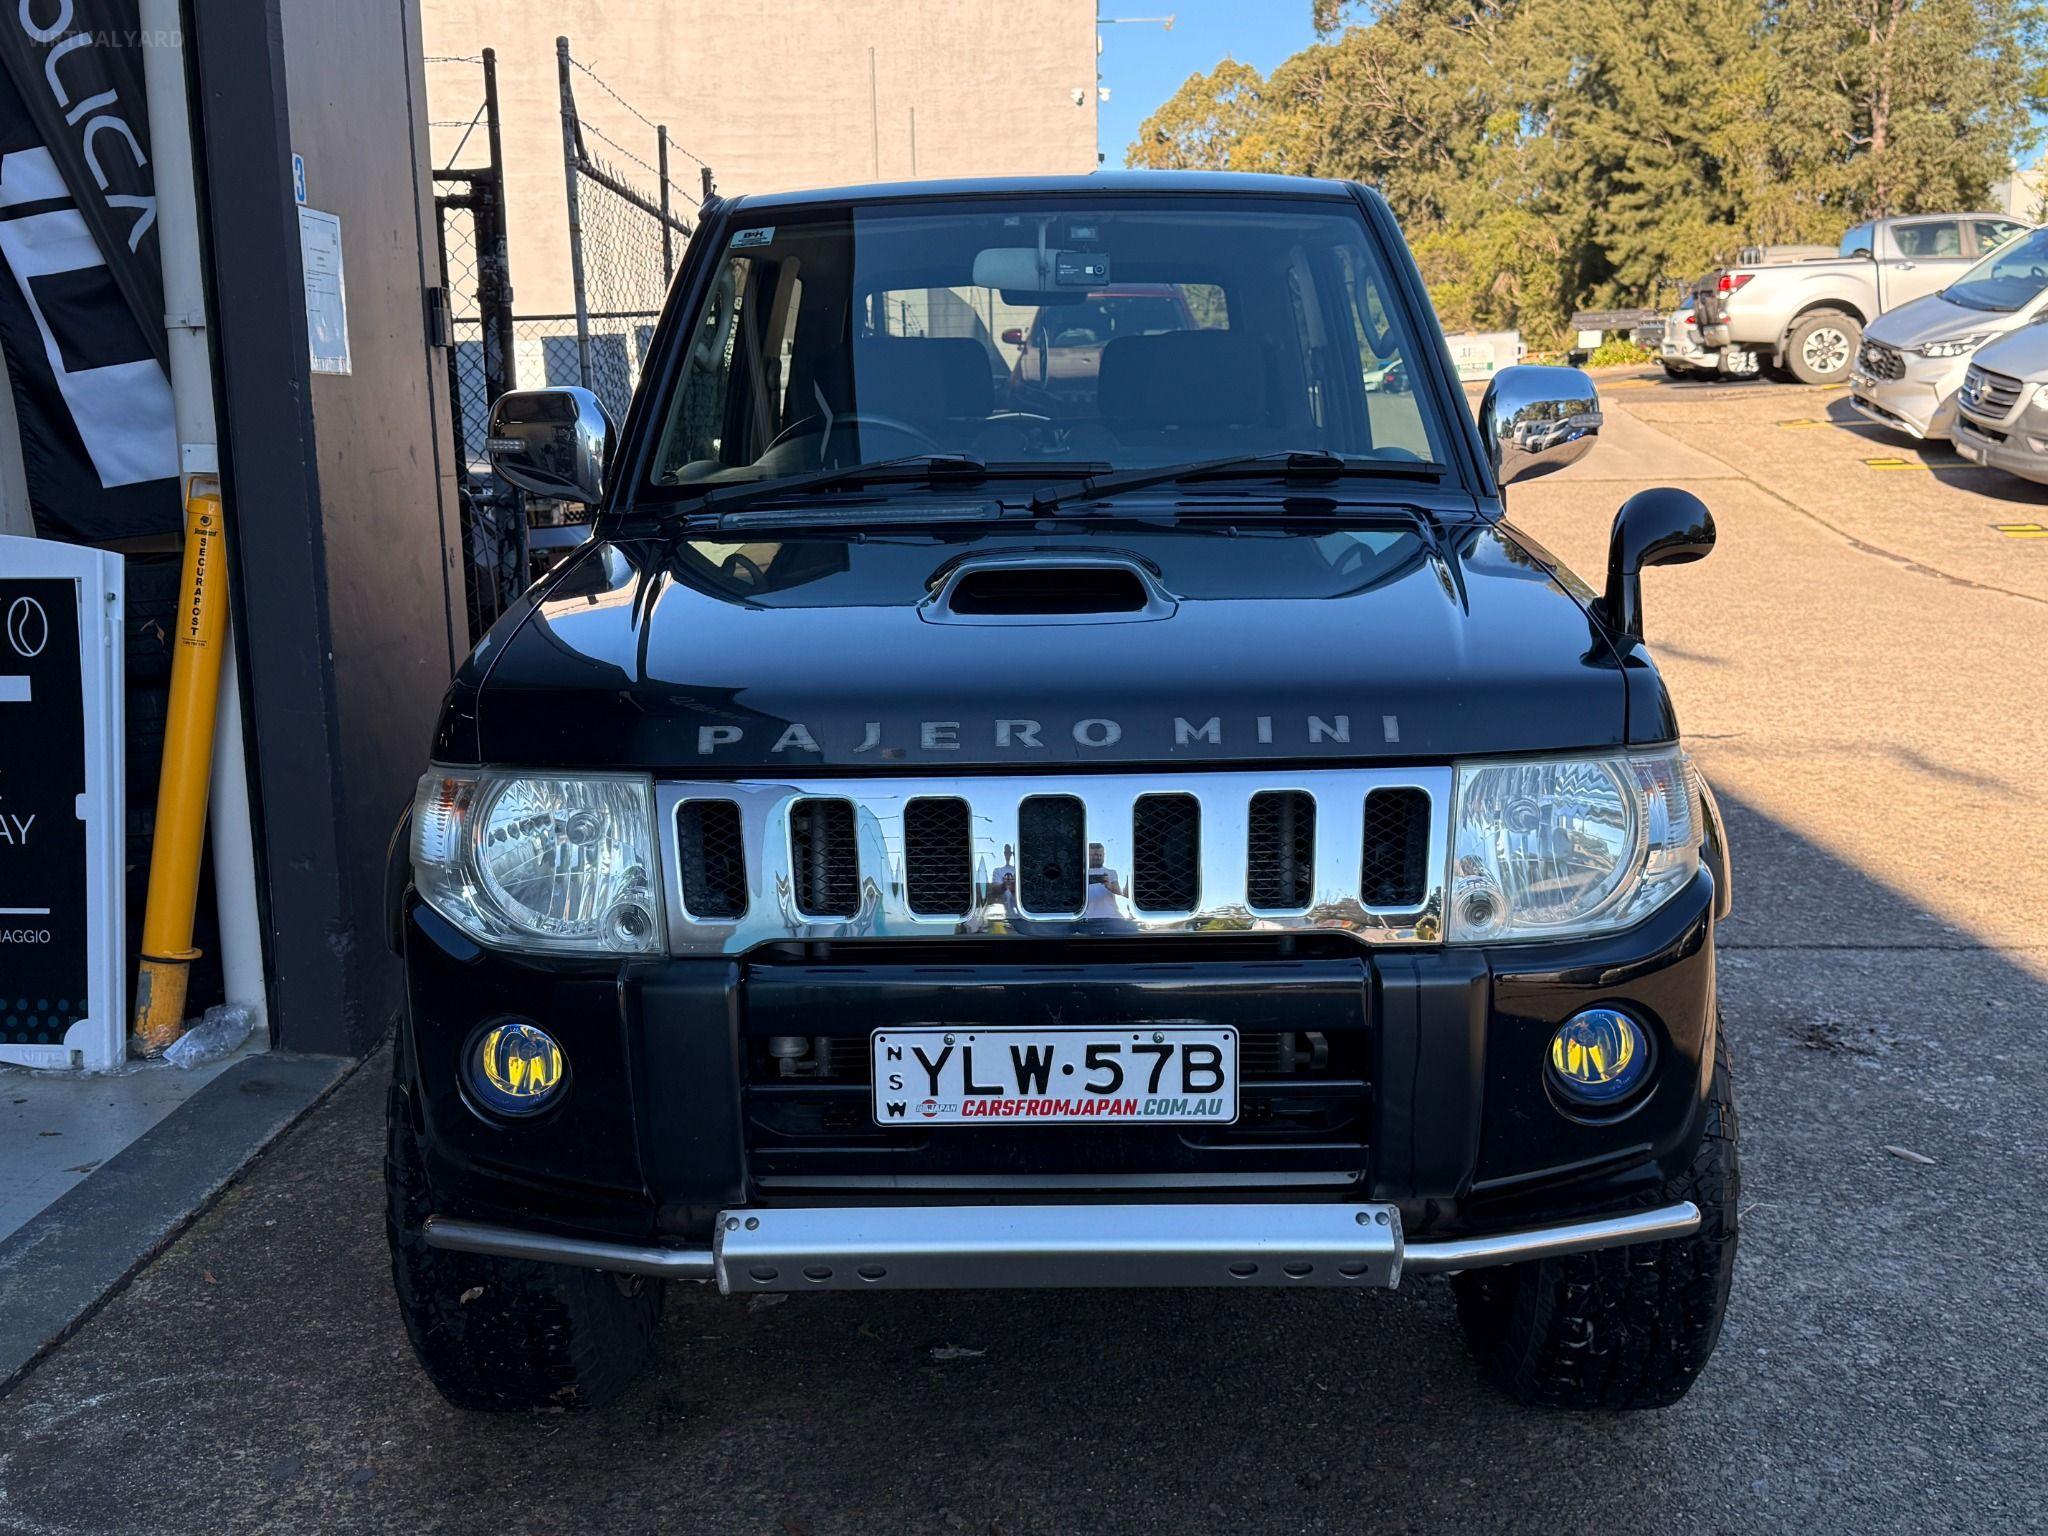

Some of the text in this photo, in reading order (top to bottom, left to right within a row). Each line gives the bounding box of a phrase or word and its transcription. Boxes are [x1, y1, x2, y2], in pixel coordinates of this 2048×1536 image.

[190, 537, 208, 636] SECURAPOST
[698, 715, 1400, 755] PAJERO MINI
[961, 1098, 1223, 1117] CARSFROMJAPAN.COM.AU
